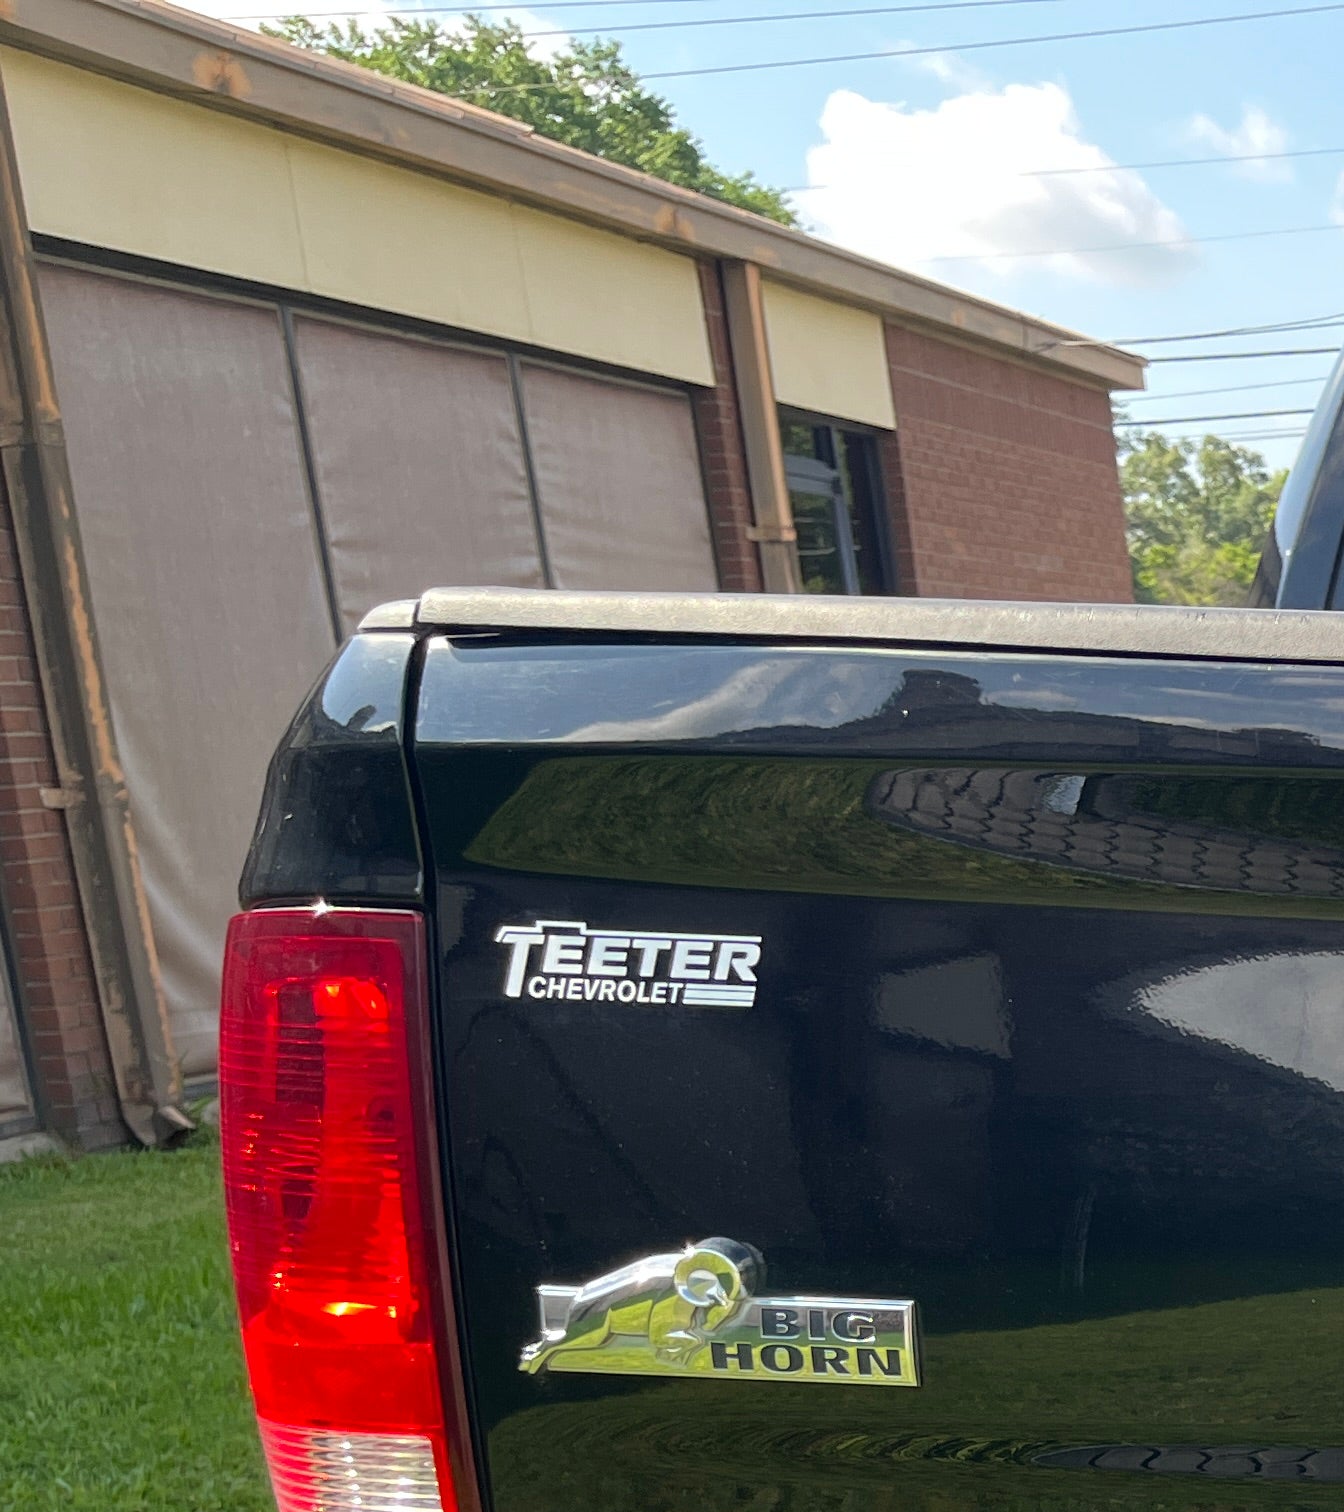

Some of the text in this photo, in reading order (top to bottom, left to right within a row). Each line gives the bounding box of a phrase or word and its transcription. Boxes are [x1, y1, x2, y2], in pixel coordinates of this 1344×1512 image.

[498, 932, 762, 998] TEETER
[527, 975, 686, 1004] CHEVROLET
[760, 1307, 877, 1343] BIG
[710, 1342, 901, 1377] HORN
